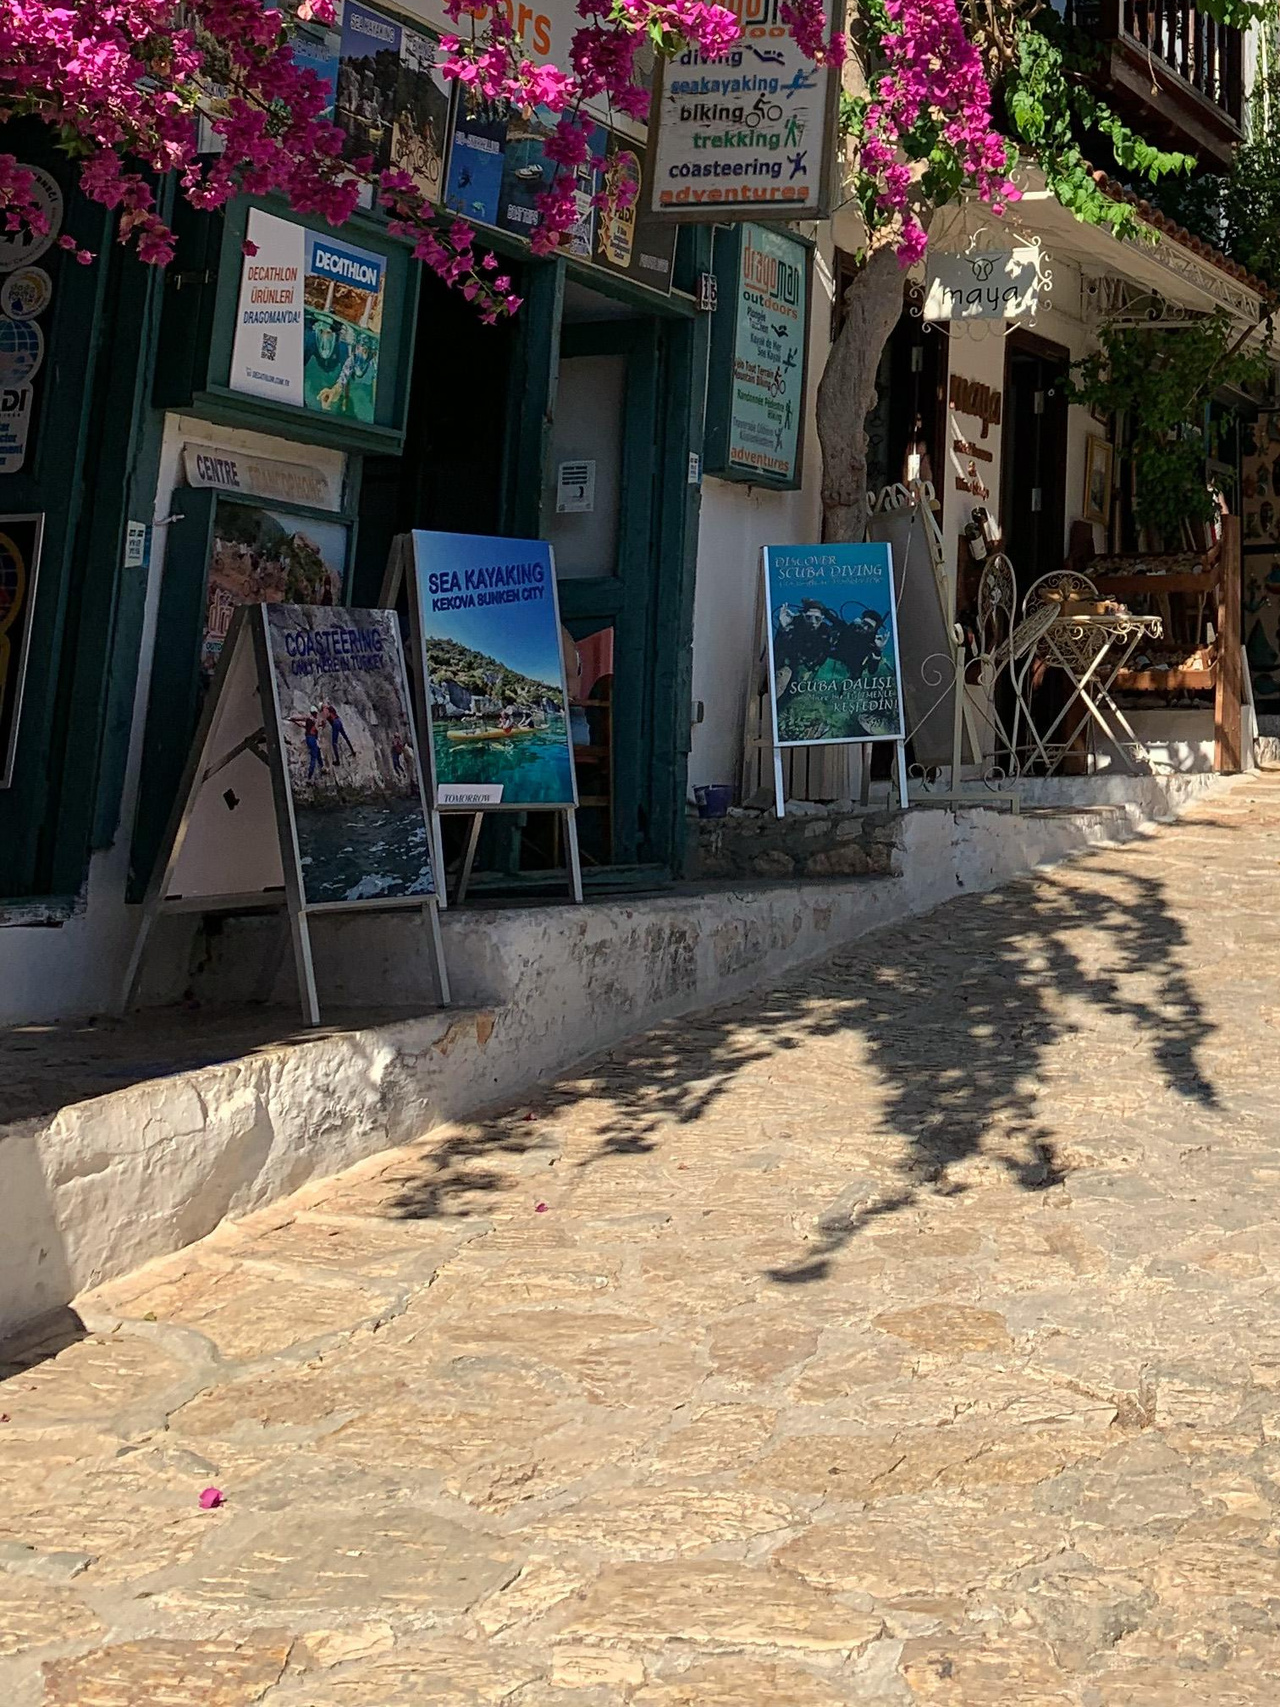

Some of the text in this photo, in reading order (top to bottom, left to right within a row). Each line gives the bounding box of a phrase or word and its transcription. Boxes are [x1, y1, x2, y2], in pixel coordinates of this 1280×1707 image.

[670, 76, 779, 95] seakayaking
[681, 104, 744, 123] biking
[692, 130, 780, 149] trekking
[669, 158, 782, 178] coasteering
[659, 184, 810, 203] adventures
[247, 266, 298, 282] DECATHLON
[315, 249, 377, 286] DECATHLON
[743, 230, 800, 306] dragoman
[250, 286, 294, 304] ÜRÜNLERİ
[942, 284, 1019, 311] maya
[743, 291, 798, 321] outdoors
[243, 309, 300, 325] DRAGOMAN'DA!
[731, 446, 789, 472] adventures
[196, 454, 240, 487] CENTRE
[775, 555, 837, 568] DISCOVER
[428, 562, 544, 594] SEA KAYAKING
[778, 564, 882, 580] SCUBA DIVING
[432, 586, 544, 612] KEKOVA SUNKEN CITY
[285, 628, 383, 657] COASTEERING
[789, 676, 892, 694] SCUBA DALIŞI
[444, 794, 490, 803] TOMORROW
